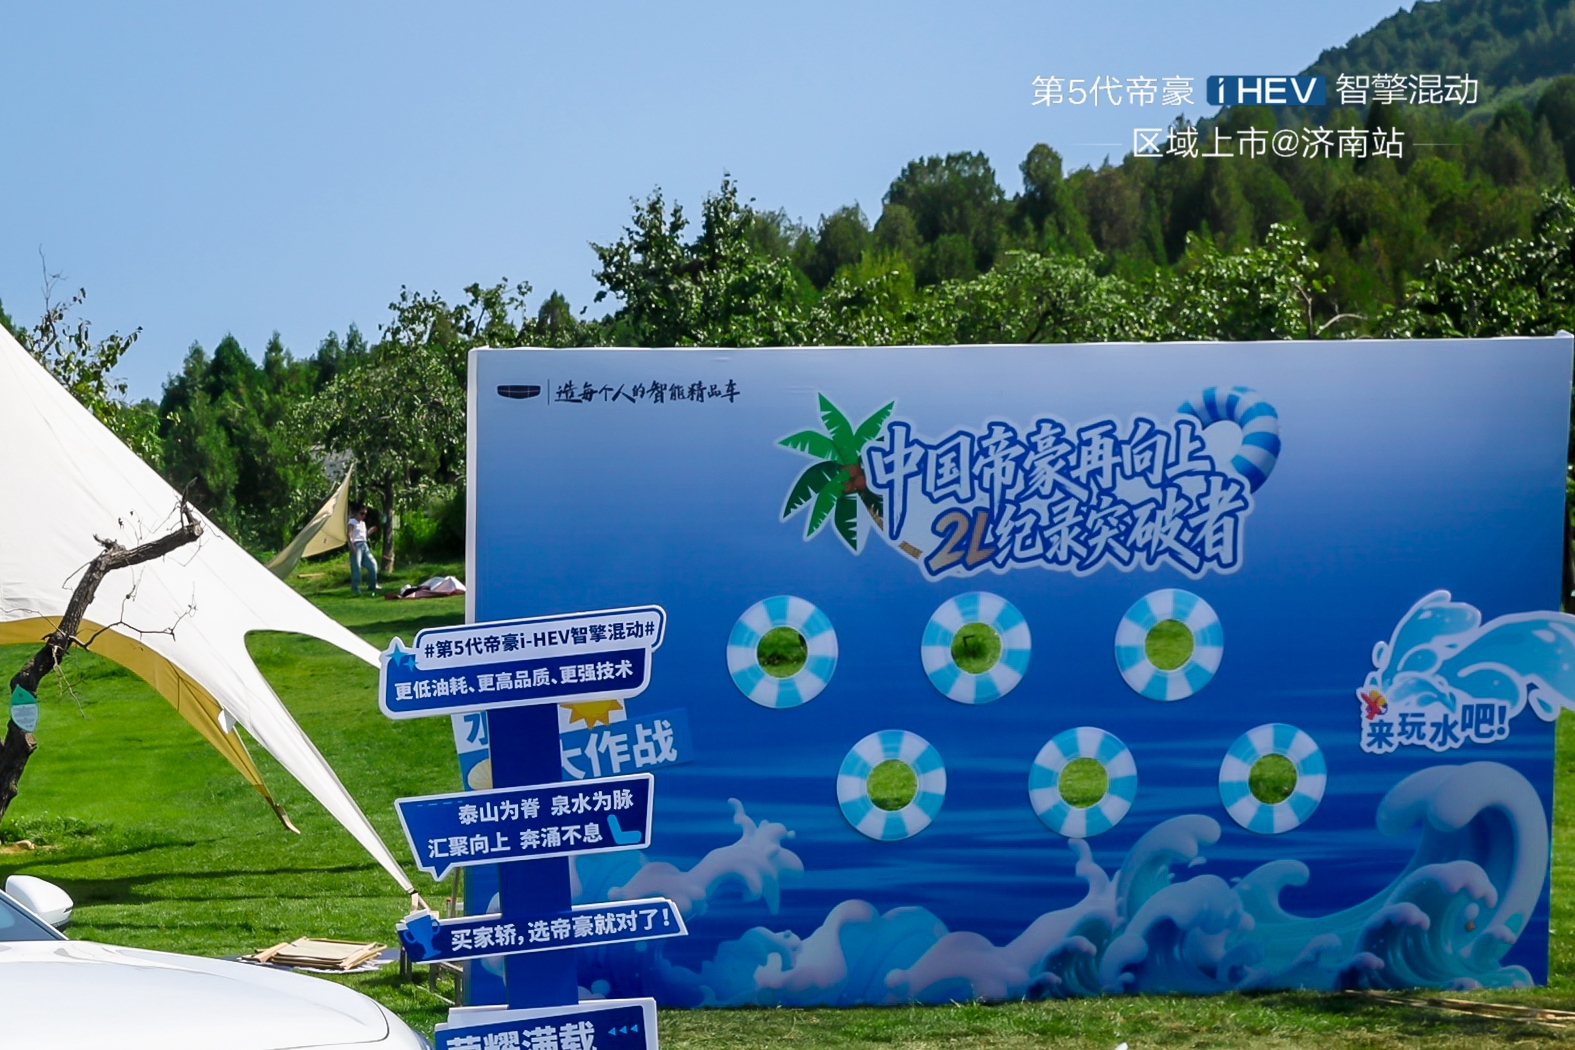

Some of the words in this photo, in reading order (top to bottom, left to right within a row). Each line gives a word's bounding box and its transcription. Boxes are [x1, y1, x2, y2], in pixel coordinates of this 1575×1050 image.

[554, 379, 741, 404] 造每个人的智能精品车
[867, 419, 1216, 537] 中国帝豪再向上
[928, 476, 1247, 573] 2L纪录突破者
[424, 620, 656, 659] #第5代帝豪i-HEV智擎混动#
[394, 660, 634, 700] 更低油耗、更高品质、更强技术
[458, 798, 541, 825] 泰山为脊
[550, 789, 634, 816] 泉水为脉
[428, 832, 512, 859] 汇聚向上
[519, 822, 604, 849] 奔涌不息
